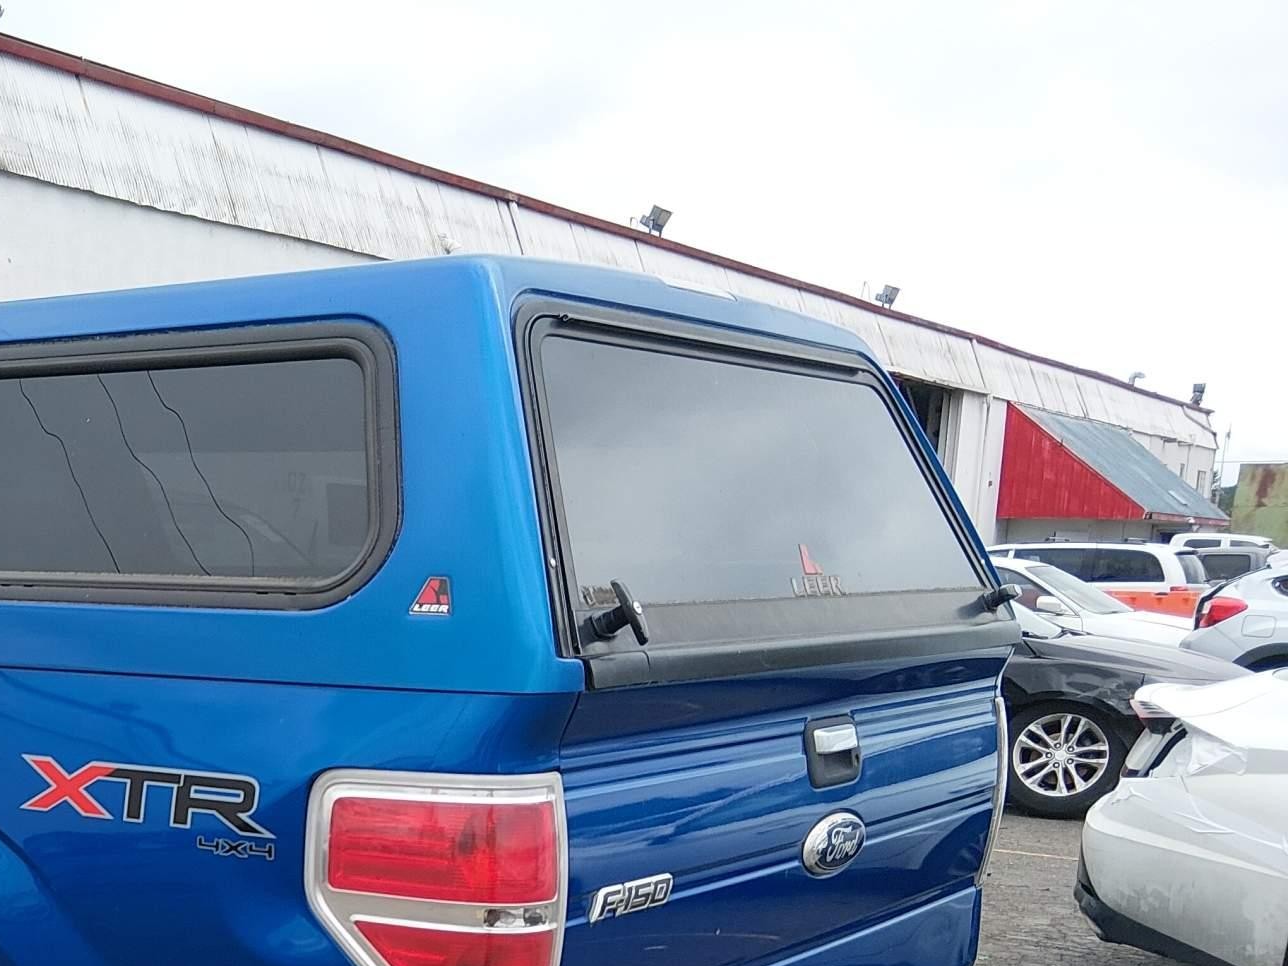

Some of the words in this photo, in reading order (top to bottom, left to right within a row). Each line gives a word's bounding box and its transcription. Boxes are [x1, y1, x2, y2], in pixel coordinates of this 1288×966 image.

[790, 575, 843, 599] LEER
[413, 603, 449, 613] LEER
[19, 753, 277, 838] XTR
[825, 826, 861, 862] Ford
